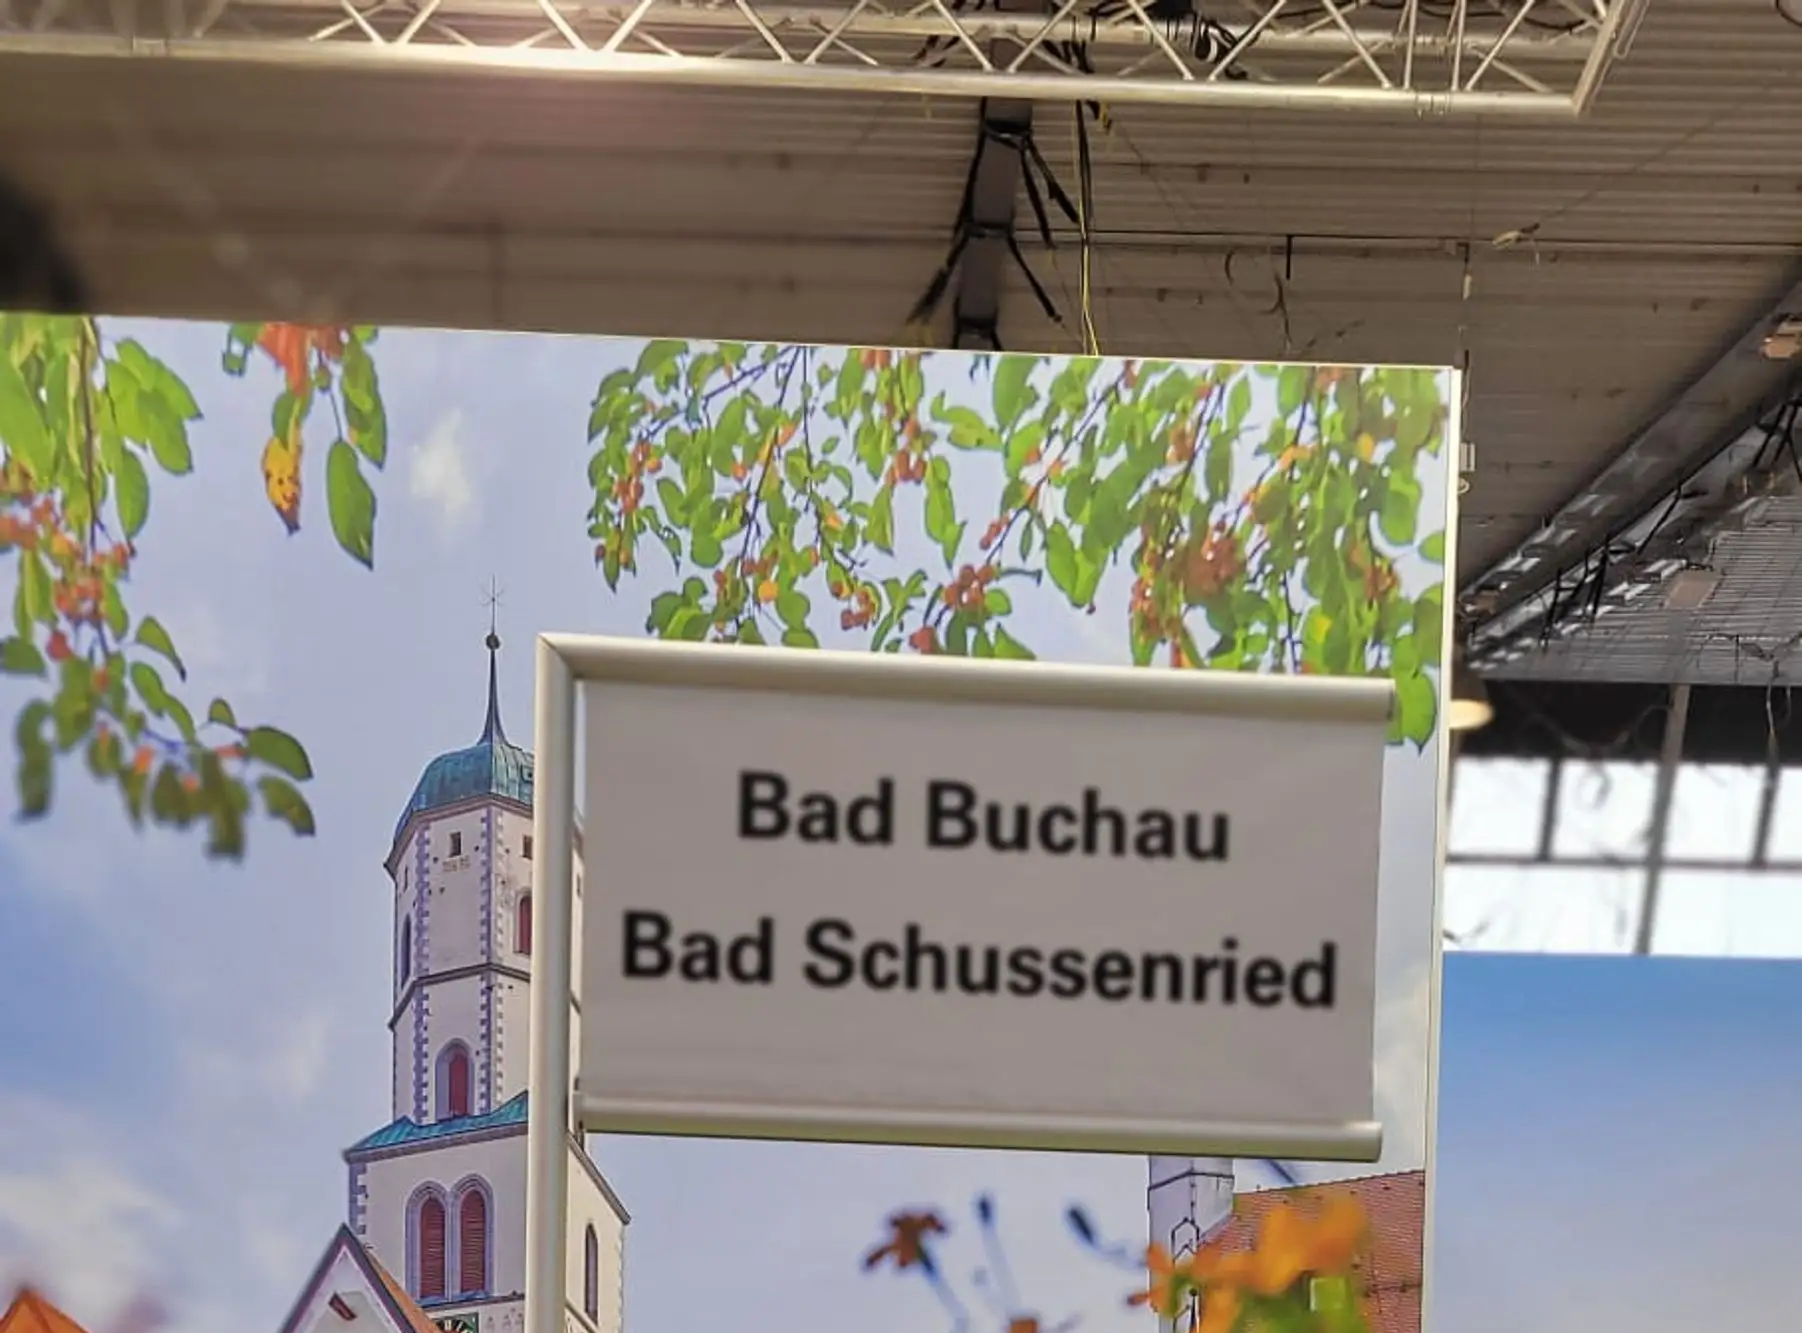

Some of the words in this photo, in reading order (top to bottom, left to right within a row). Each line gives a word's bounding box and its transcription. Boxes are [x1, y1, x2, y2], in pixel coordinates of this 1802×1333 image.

[736, 769, 896, 848] Bad
[924, 778, 1230, 863] Buchau
[620, 908, 776, 987] Bad
[801, 916, 1339, 1011] Schussenried
